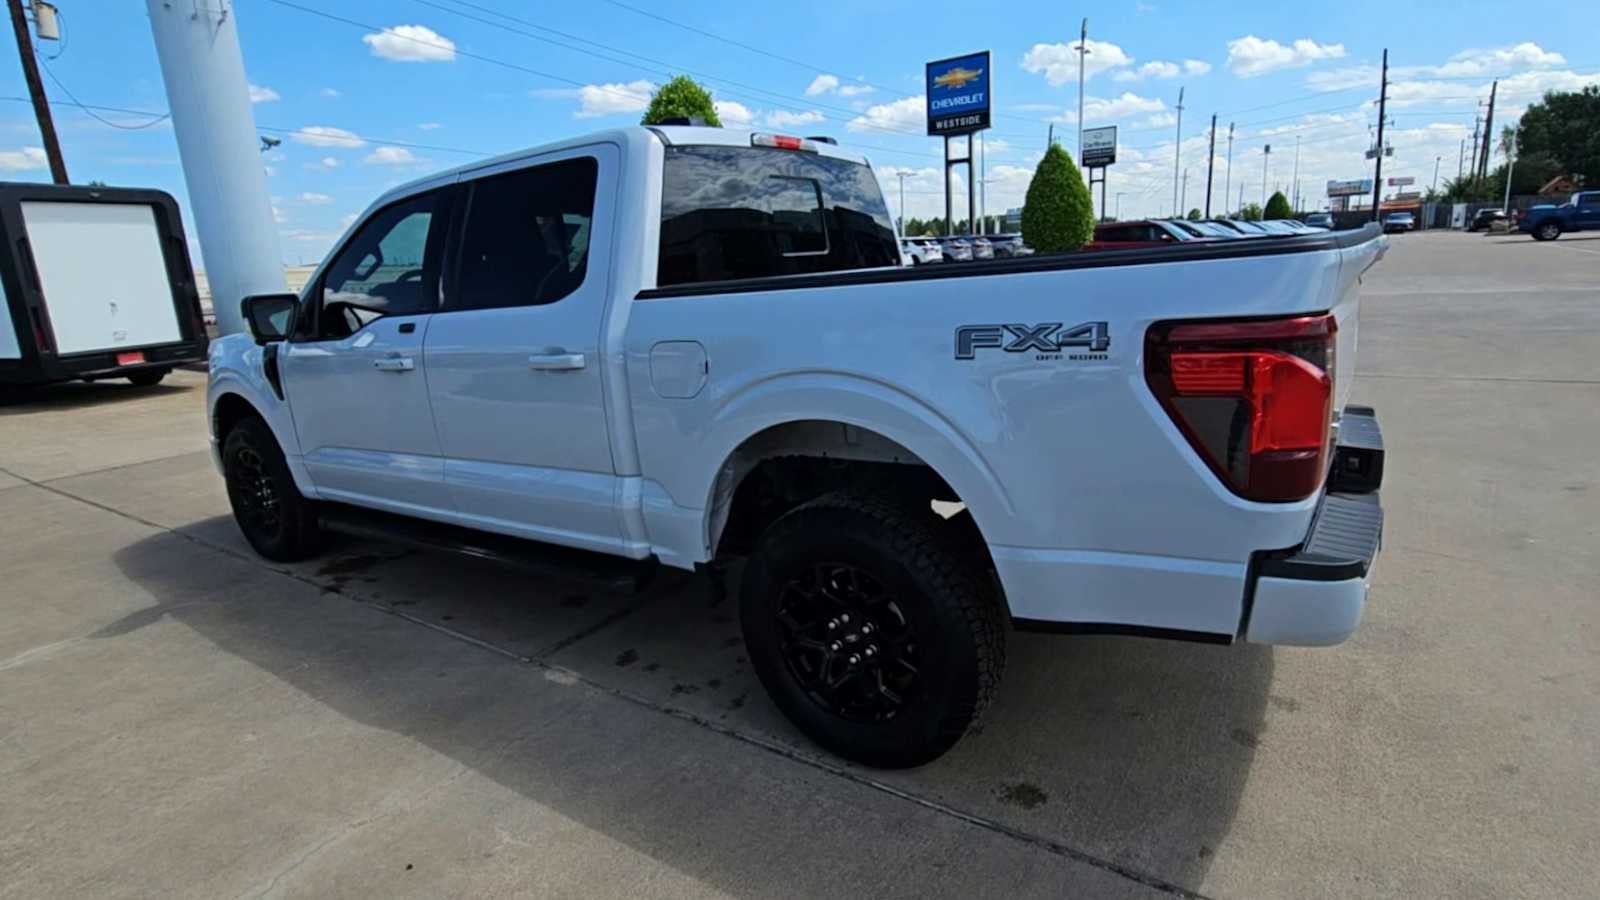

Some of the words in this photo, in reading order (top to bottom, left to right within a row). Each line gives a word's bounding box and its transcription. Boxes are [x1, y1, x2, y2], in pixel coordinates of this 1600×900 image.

[931, 93, 984, 110] CHEVROLET
[935, 114, 981, 129] WESTSIDE
[955, 321, 1110, 360] FX4
